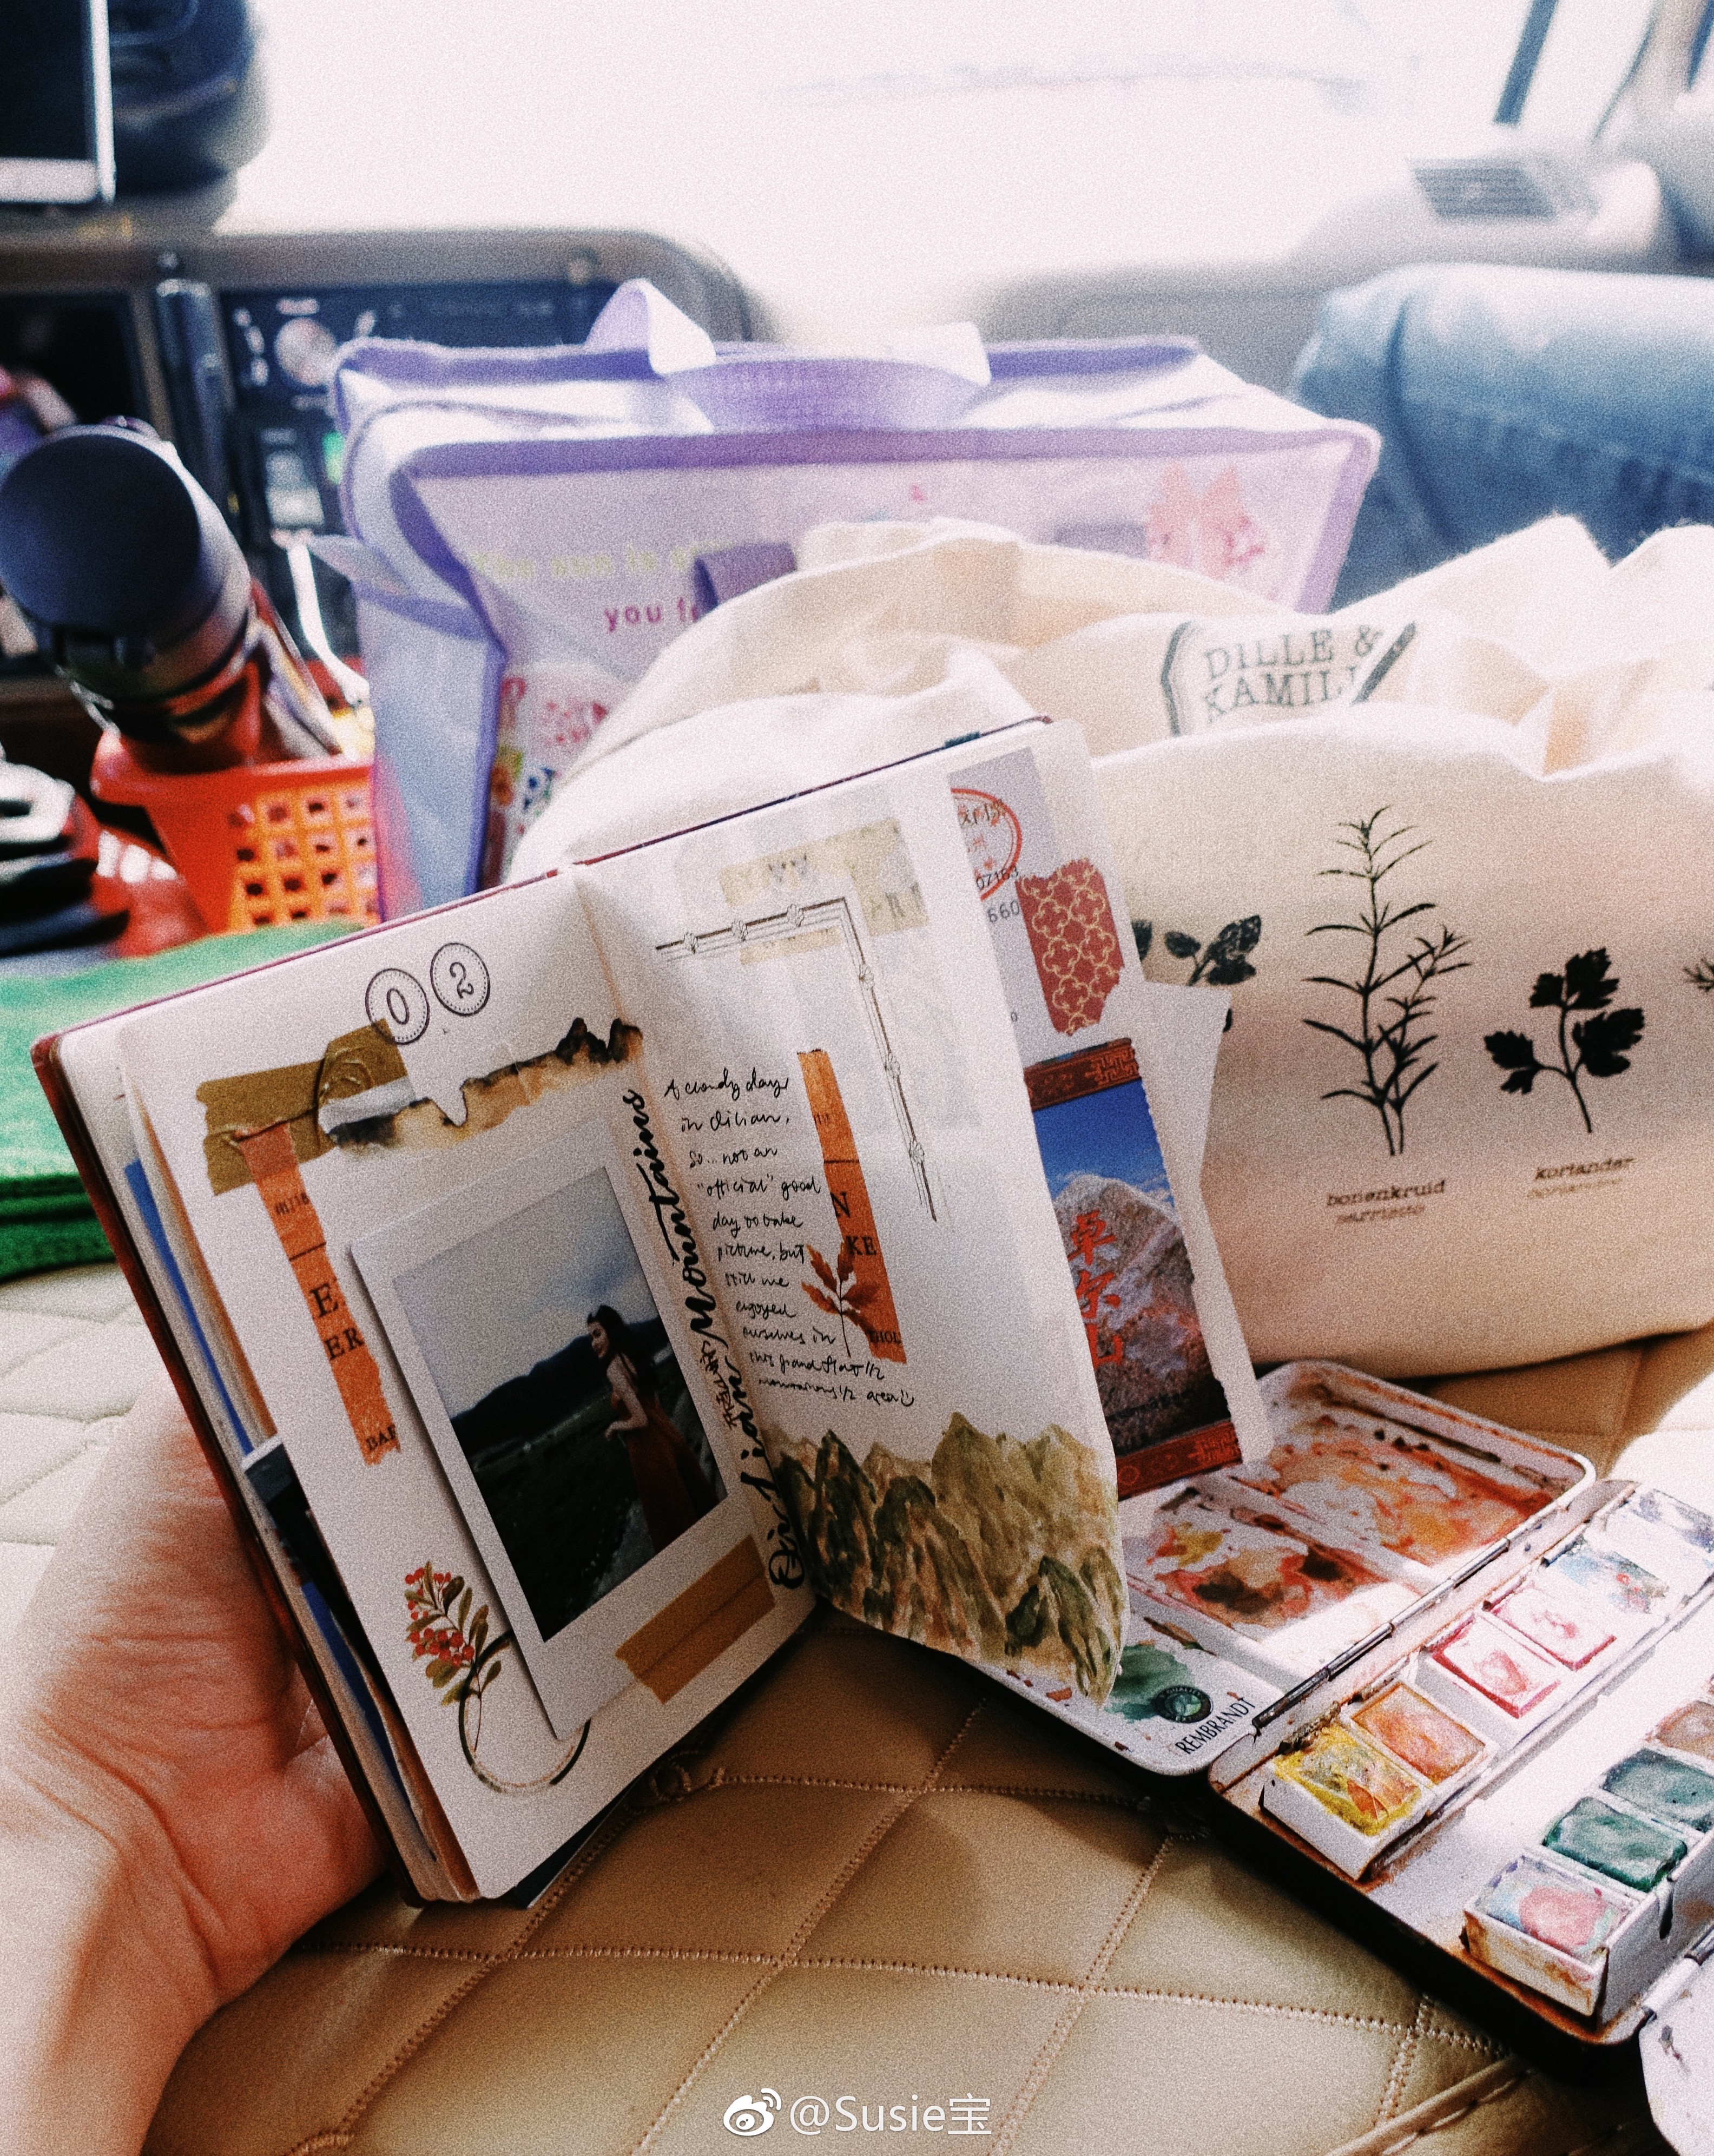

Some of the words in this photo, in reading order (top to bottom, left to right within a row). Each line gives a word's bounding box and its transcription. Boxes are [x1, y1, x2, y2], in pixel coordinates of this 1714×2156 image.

[604, 605, 663, 634] you
[1204, 628, 1334, 681] DILLE
[1354, 624, 1382, 657] &
[987, 900, 1020, 923] 660
[685, 1066, 740, 1101] cloudy
[681, 1117, 703, 1132] in
[723, 1149, 748, 1165] not
[754, 1148, 778, 1158] an
[781, 1175, 821, 1201] good
[623, 1089, 729, 1350] Mountains
[713, 1211, 741, 1238] day
[763, 1211, 804, 1228] take
[780, 1242, 805, 1264] but
[725, 1271, 756, 1287] still
[736, 1300, 797, 1320] enjoyed
[325, 1327, 365, 1361] ER
[743, 1327, 806, 1344] ourselves
[812, 1326, 836, 1344] in
[1175, 1697, 1255, 1755] REMBRANDT
